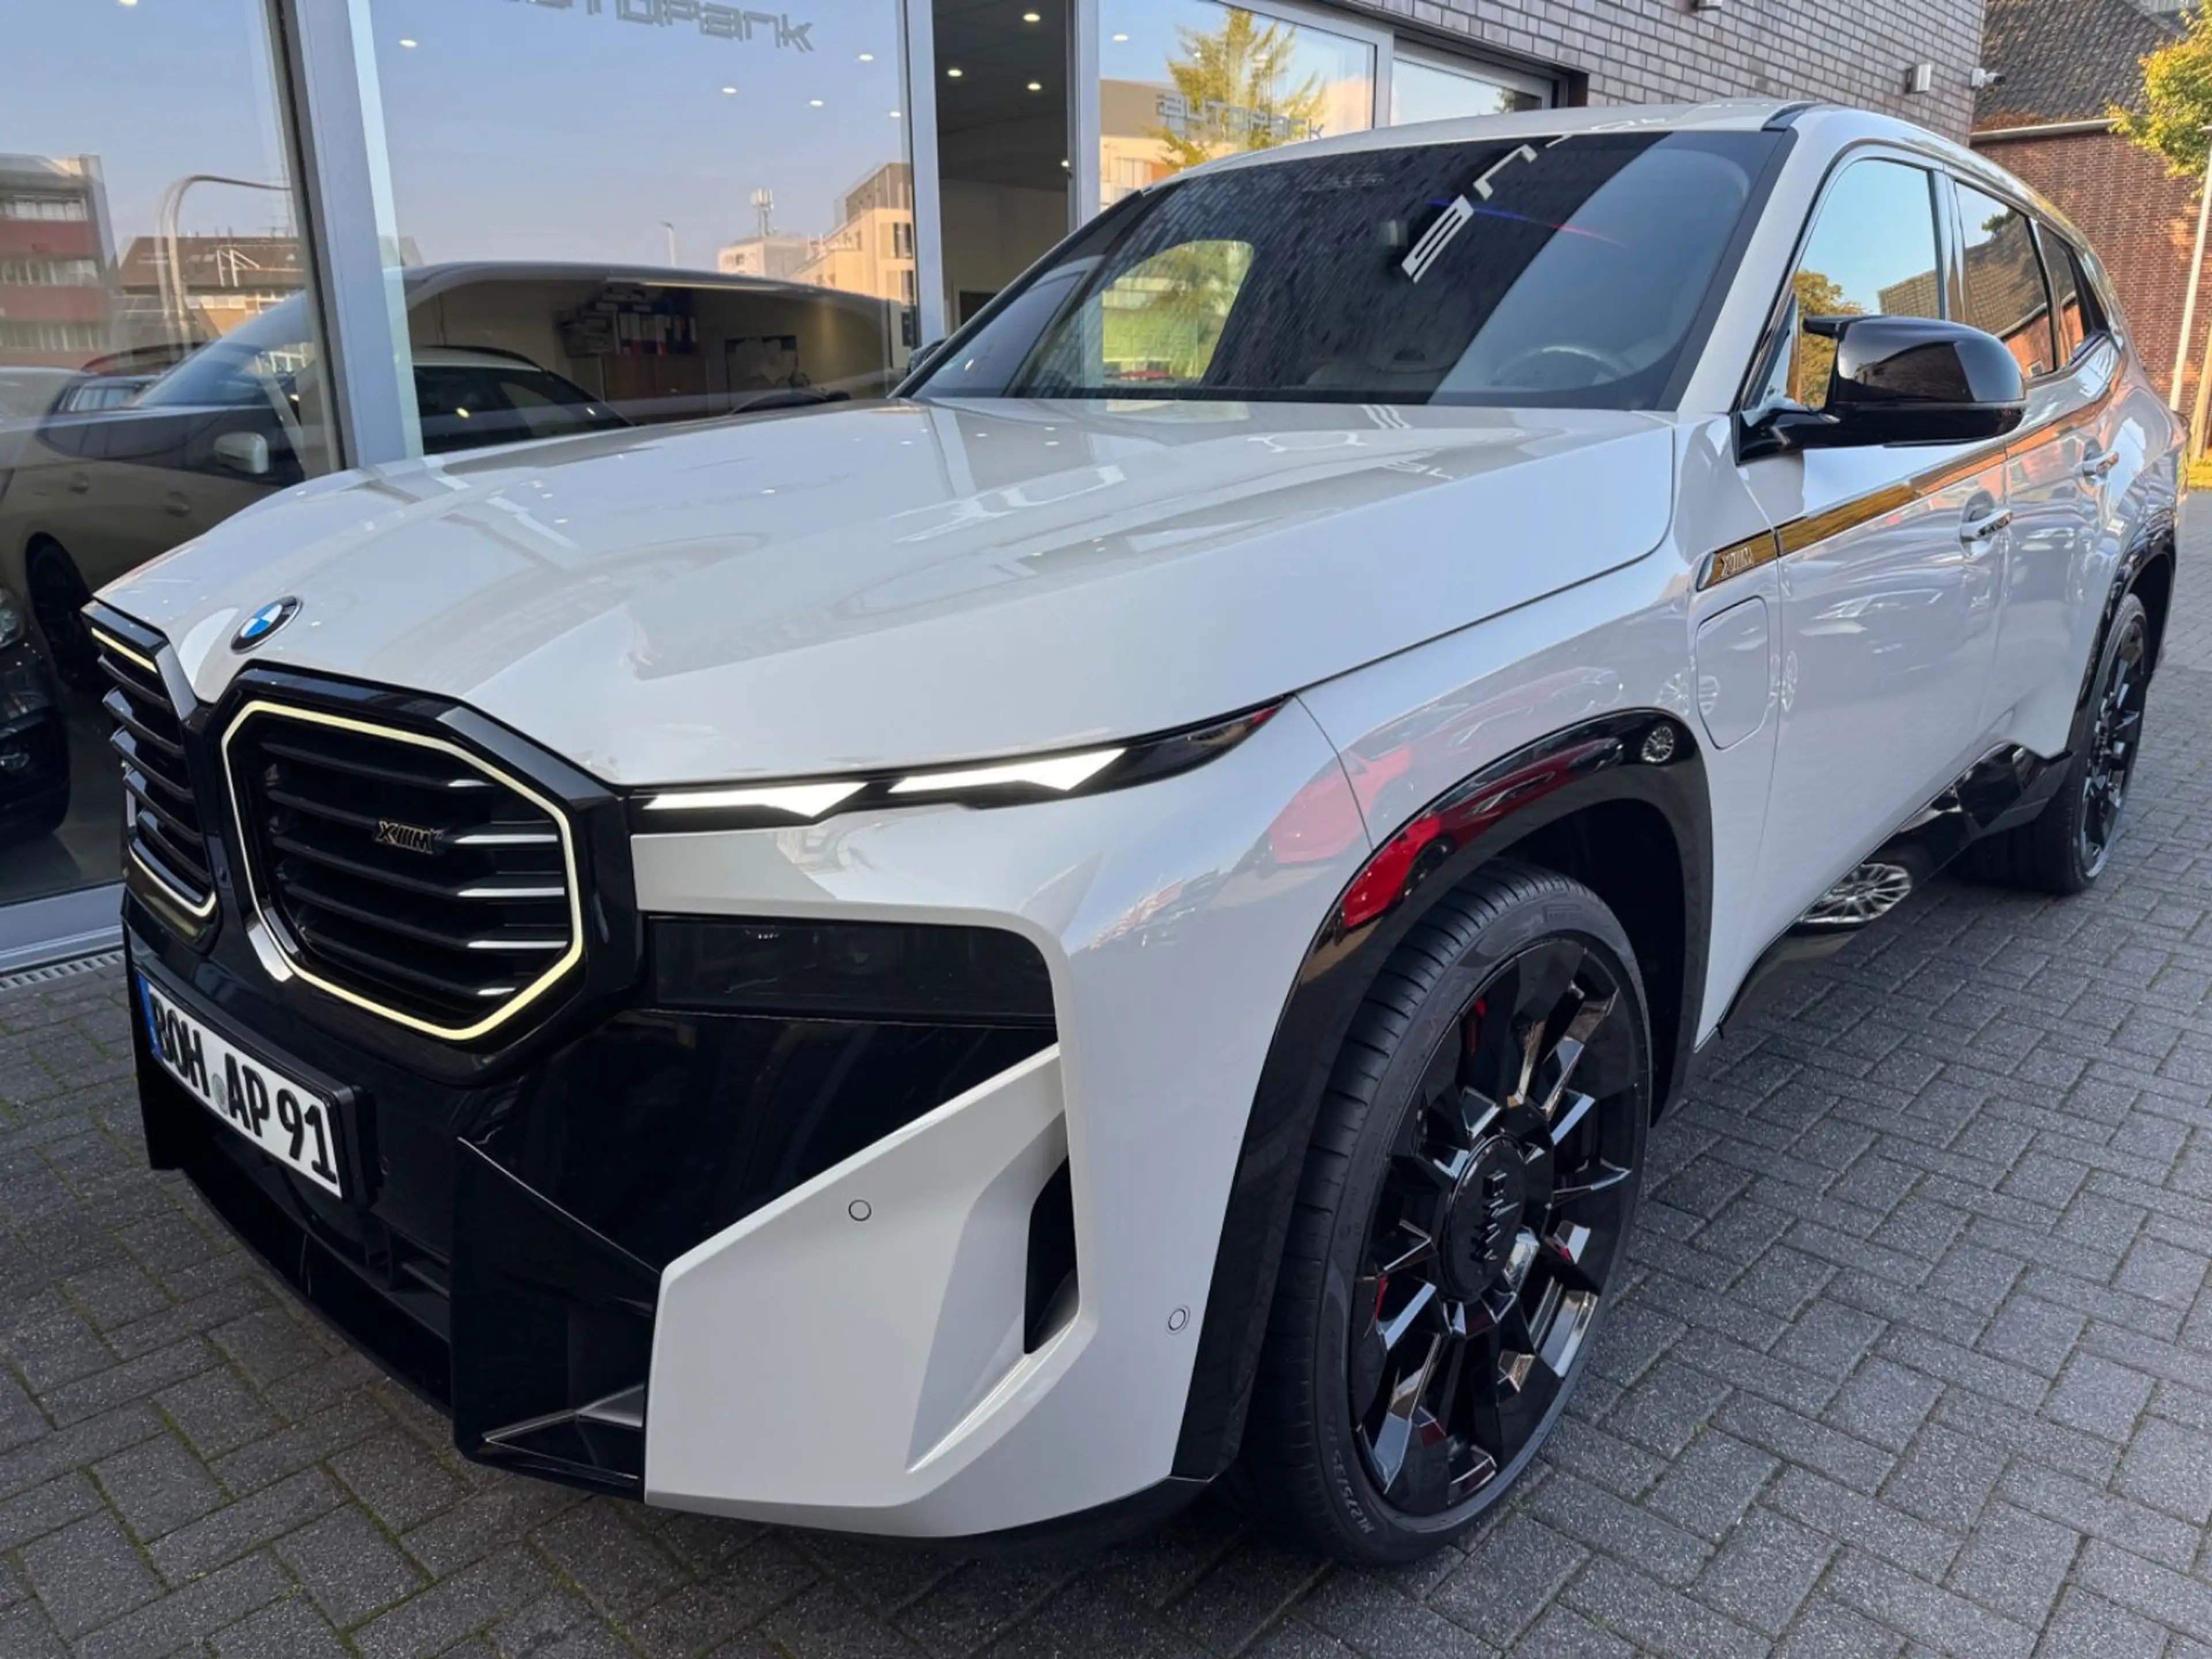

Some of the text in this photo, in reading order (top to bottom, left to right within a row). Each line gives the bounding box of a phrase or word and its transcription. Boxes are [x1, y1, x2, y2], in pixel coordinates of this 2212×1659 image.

[151, 993, 337, 1184] BOH AP 91
